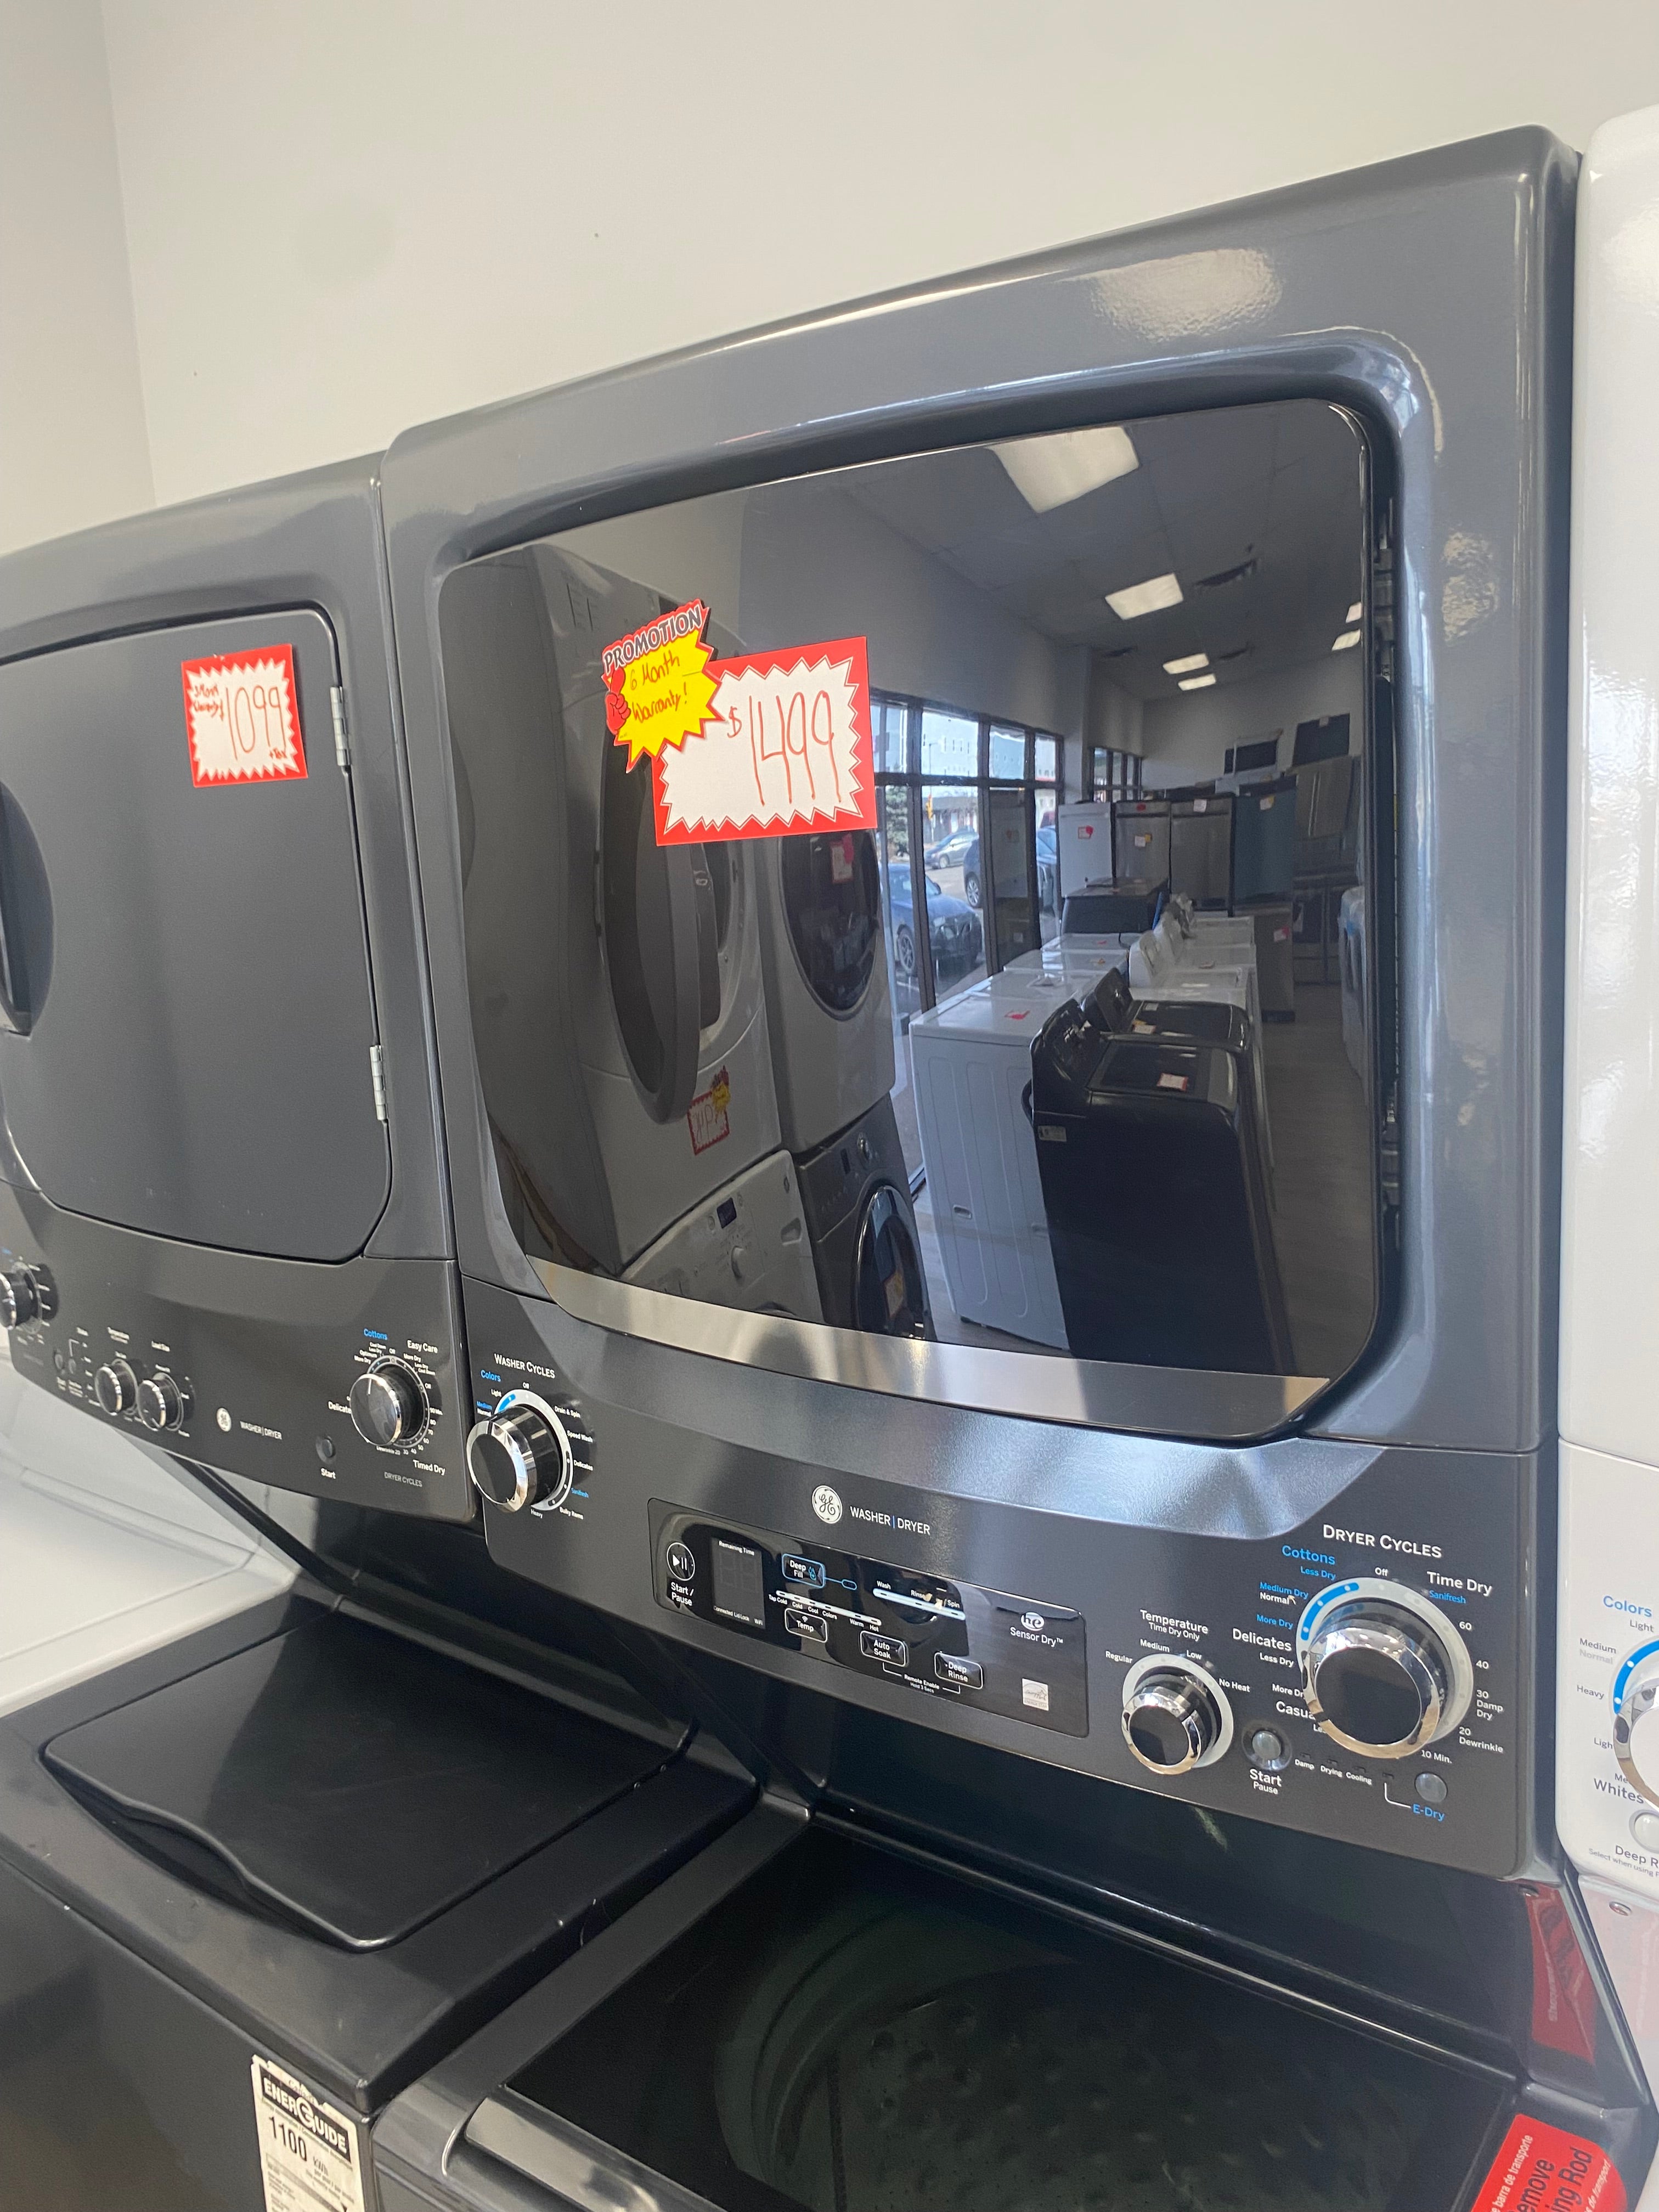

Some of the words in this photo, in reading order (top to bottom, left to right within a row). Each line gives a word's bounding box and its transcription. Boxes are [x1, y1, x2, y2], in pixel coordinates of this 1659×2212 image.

[604, 605, 702, 674] PROMOTION
[630, 669, 637, 690] 6
[642, 650, 680, 685] Month
[364, 1328, 387, 1340] Cottons
[407, 1340, 422, 1352] Easy
[422, 1343, 438, 1353] Care
[494, 1353, 525, 1370] WASHER
[526, 1361, 555, 1379] CYCLES
[481, 1370, 501, 1382] Colors
[491, 1389, 502, 1397] Light
[328, 1401, 352, 1414] Delicate
[554, 1406, 566, 1414] Drain
[571, 1410, 580, 1418] Spin
[240, 1421, 261, 1435] WASHER
[264, 1428, 282, 1440] DRYER
[567, 1430, 580, 1440] Speed
[580, 1434, 592, 1443] Wash
[413, 1459, 433, 1471] Timed
[434, 1464, 445, 1476] Dry
[573, 1459, 593, 1471] Delicates
[321, 1468, 336, 1479] Start
[385, 1472, 402, 1482] DRYER
[402, 1476, 422, 1487] CYCLES
[531, 1509, 543, 1519] Heavy
[850, 1506, 891, 1526] WASHER
[898, 1517, 930, 1535] DRYER
[1323, 1524, 1375, 1547] DRYER
[1380, 1535, 1442, 1559] CYCLES
[719, 1541, 742, 1553] Remaining
[743, 1547, 754, 1556] Time
[1282, 1545, 1335, 1565] Cottons
[789, 1560, 806, 1572] Deep
[1375, 1567, 1388, 1577] Off
[794, 1570, 803, 1578] Fill
[1300, 1566, 1319, 1576] Less
[1321, 1570, 1336, 1581] Dry
[671, 1582, 689, 1595] Start
[877, 1581, 891, 1590] Wash
[1260, 1582, 1291, 1595] Medium
[1294, 1588, 1308, 1599] Dry
[1427, 1571, 1463, 1589] Time
[1467, 1578, 1493, 1597] Dry
[672, 1592, 692, 1606] Pause
[777, 1596, 788, 1605] Cold
[1260, 1592, 1289, 1605] Normal
[1429, 1590, 1466, 1604] Sanifresh
[713, 1605, 733, 1616] Connected
[792, 1601, 803, 1610] Cold
[947, 1599, 960, 1609] Spin
[1603, 1595, 1652, 1618] Colors
[822, 1610, 837, 1620] Colors
[1140, 1609, 1209, 1634] Temperature
[797, 1620, 814, 1633] Temp
[849, 1618, 864, 1628] Warm
[1256, 1614, 1277, 1625] More
[1278, 1619, 1294, 1630] Dry
[1459, 1621, 1472, 1630] 60
[1629, 1620, 1654, 1633] Light
[1010, 1626, 1040, 1641] Sensor
[1149, 1622, 1167, 1633] Time
[1169, 1628, 1181, 1638] Dry
[1183, 1630, 1200, 1641] Only
[874, 1639, 890, 1650] Auto
[1140, 1639, 1170, 1652] Medium
[1233, 1628, 1292, 1651] Delicates
[1579, 1638, 1616, 1654] Medium
[874, 1647, 891, 1659] Soak
[1105, 1651, 1133, 1664] Regular
[1187, 1650, 1201, 1660] Low
[1579, 1649, 1613, 1664] Normal
[1260, 1652, 1277, 1663] Less
[1279, 1656, 1294, 1668] Dry
[1476, 1660, 1489, 1669] 40
[948, 1661, 967, 1674] Deep
[904, 1674, 923, 1685] Remote
[923, 1679, 940, 1689] Enable
[948, 1670, 968, 1682] Rinse
[1219, 1678, 1230, 1687] No
[1231, 1681, 1250, 1692] Heat
[1272, 1683, 1293, 1695] More
[1476, 1689, 1489, 1699] 30
[1577, 1685, 1605, 1700] Heavy
[1276, 1701, 1316, 1720] Casua
[1477, 1700, 1504, 1712] Damp
[1477, 1709, 1493, 1721] Dry
[1459, 1726, 1471, 1736] 20
[1459, 1736, 1504, 1753] Dewrinkle
[1594, 1737, 1613, 1749] Ligh
[1421, 1750, 1431, 1758] 10
[1434, 1752, 1452, 1764] Min.
[1295, 1759, 1314, 1770] Damp
[1250, 1768, 1282, 1787] Start
[1321, 1765, 1342, 1778] Drying
[1346, 1772, 1372, 1785] Cooling
[1253, 1781, 1278, 1795] Pause
[1593, 1778, 1644, 1804] Whites
[1413, 1803, 1444, 1822] E-Dry
[1615, 1845, 1646, 1864] Deep
[1589, 1848, 1611, 1861] Select
[1612, 1858, 1632, 1868] when
[1633, 1865, 1654, 1877] using
[263, 2077, 347, 2154] ENERGUIDE
[269, 2117, 307, 2162] 1100
[1508, 2135, 1533, 2174] transporte
[1558, 2146, 1592, 2186] Rod
[1503, 2174, 1516, 2185] de
[1492, 2184, 1510, 2207] barra
